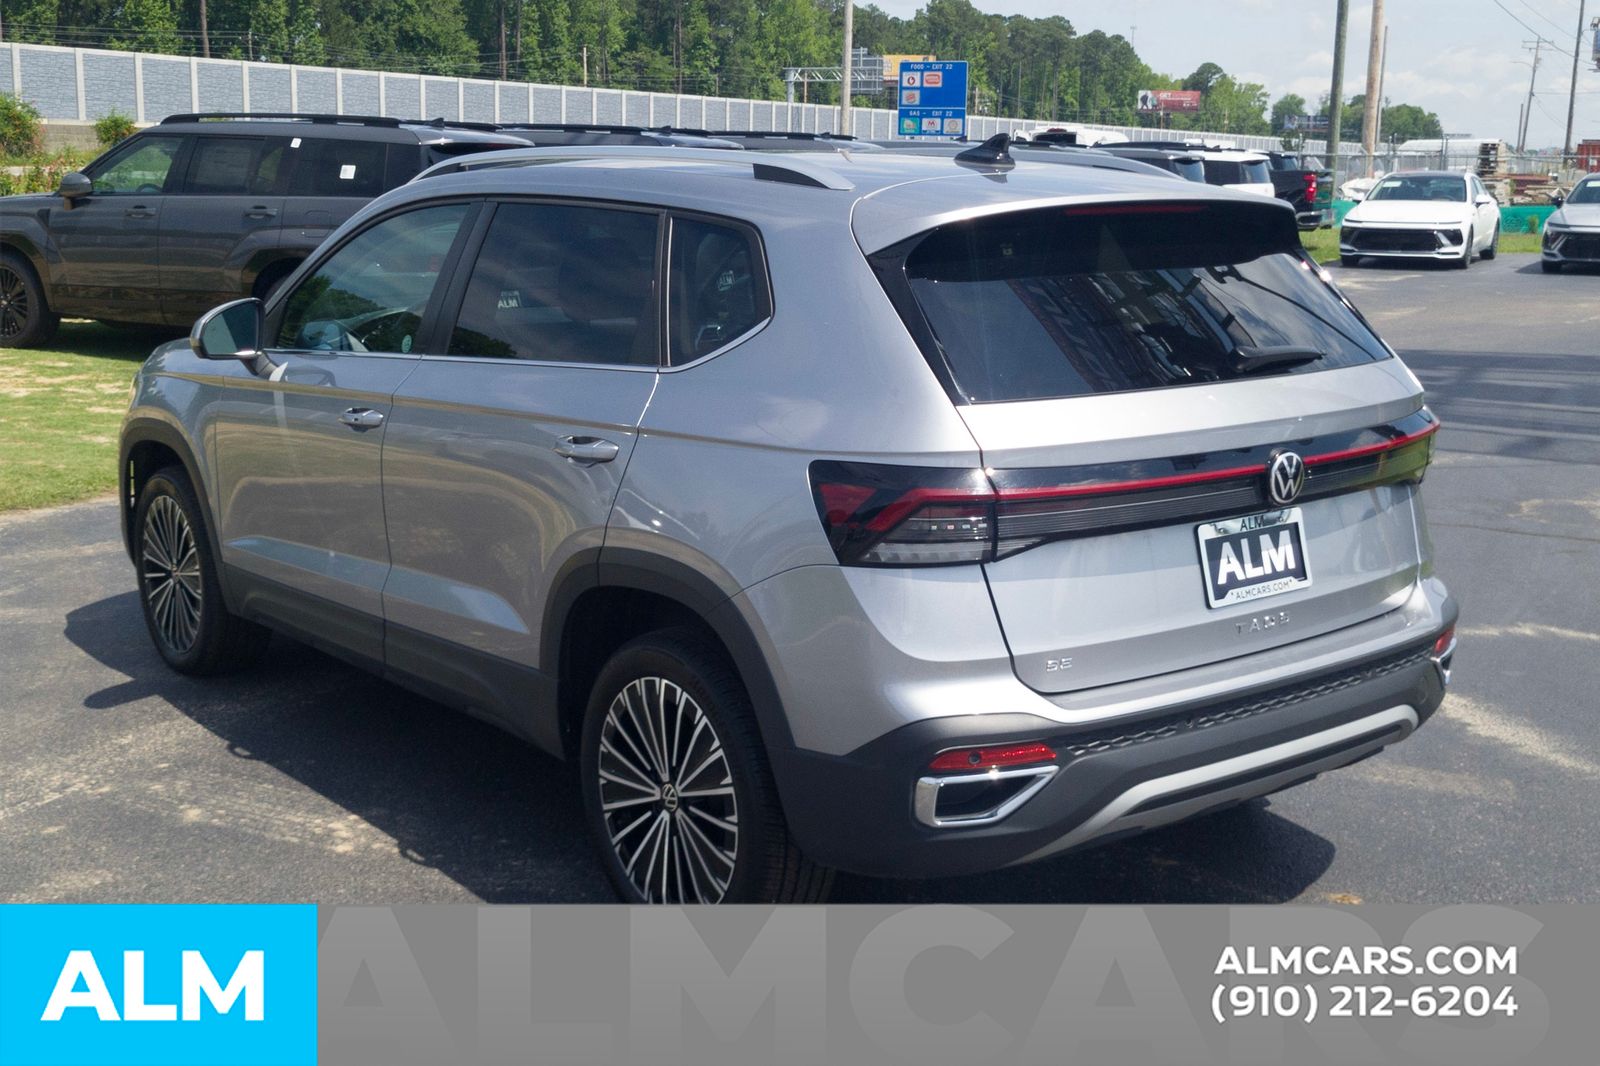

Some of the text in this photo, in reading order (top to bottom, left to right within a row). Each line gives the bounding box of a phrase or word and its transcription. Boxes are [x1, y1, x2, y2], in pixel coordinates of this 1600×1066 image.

[497, 299, 519, 309] ALM
[1240, 514, 1265, 532] ALM
[1217, 530, 1296, 585] ALM
[1046, 657, 1073, 672] SE
